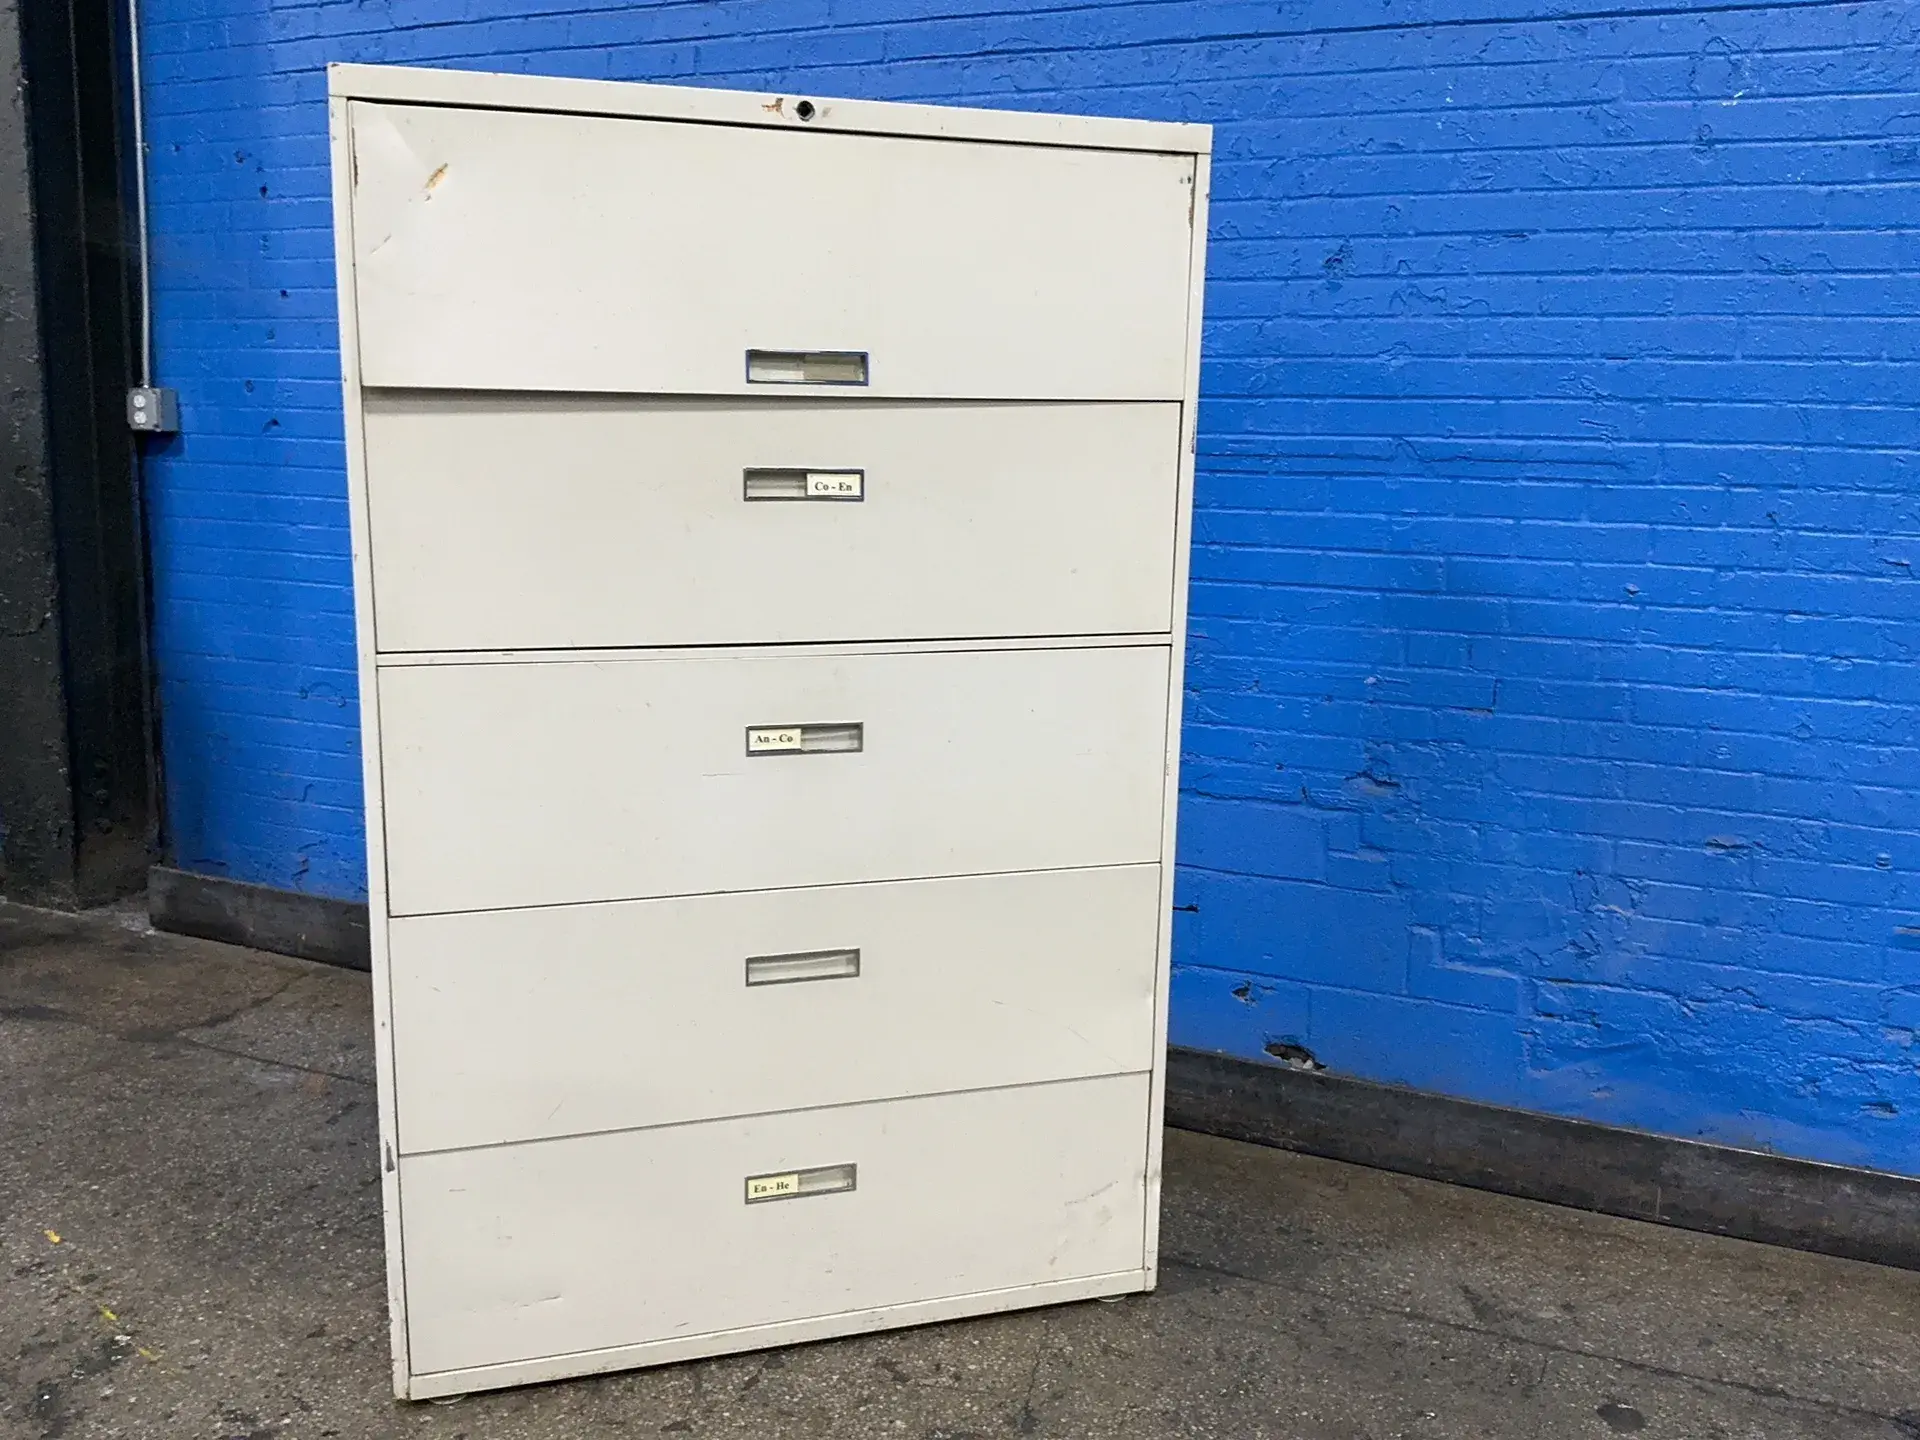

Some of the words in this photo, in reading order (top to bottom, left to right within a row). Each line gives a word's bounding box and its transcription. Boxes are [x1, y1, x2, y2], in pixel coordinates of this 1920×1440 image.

[814, 481, 829, 491] Co
[838, 481, 852, 491] En
[755, 735, 770, 743] An
[779, 733, 793, 743] Co
[754, 1184, 767, 1193] En
[776, 1181, 789, 1190] He
